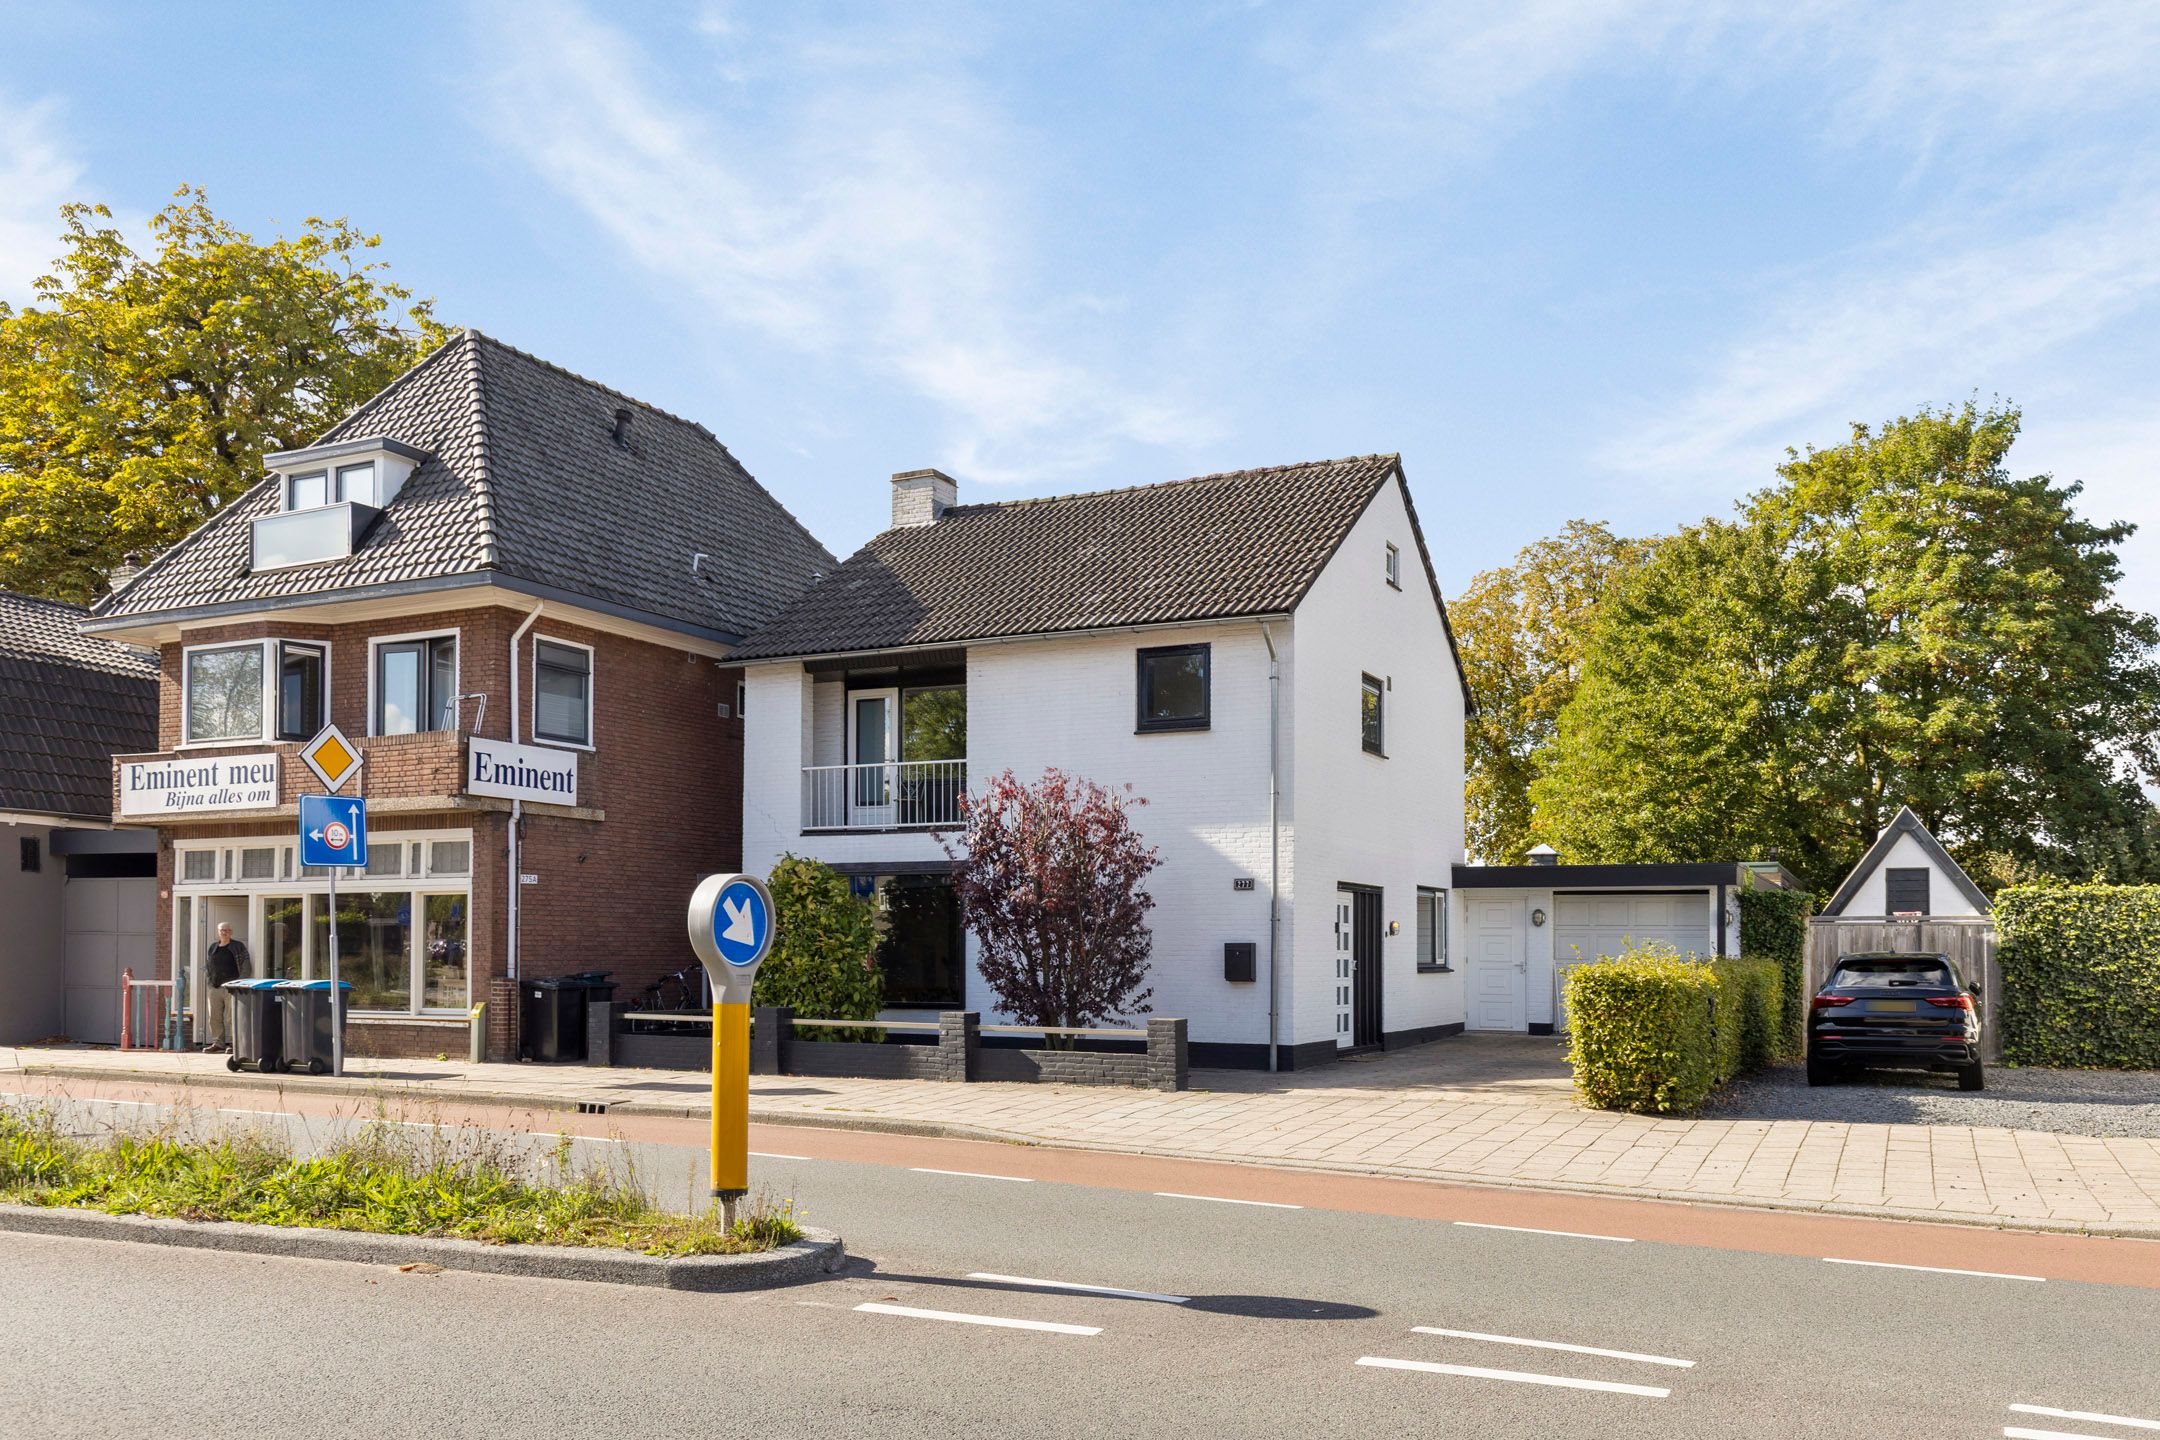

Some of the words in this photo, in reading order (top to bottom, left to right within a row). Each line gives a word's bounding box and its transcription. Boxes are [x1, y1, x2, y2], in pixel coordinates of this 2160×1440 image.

[130, 761, 218, 791] Eminent
[229, 762, 275, 785] meu
[474, 751, 574, 794] Eminent
[165, 790, 203, 810] Bijna
[208, 788, 242, 805] alles
[247, 790, 271, 803] om
[521, 875, 537, 883] 275A
